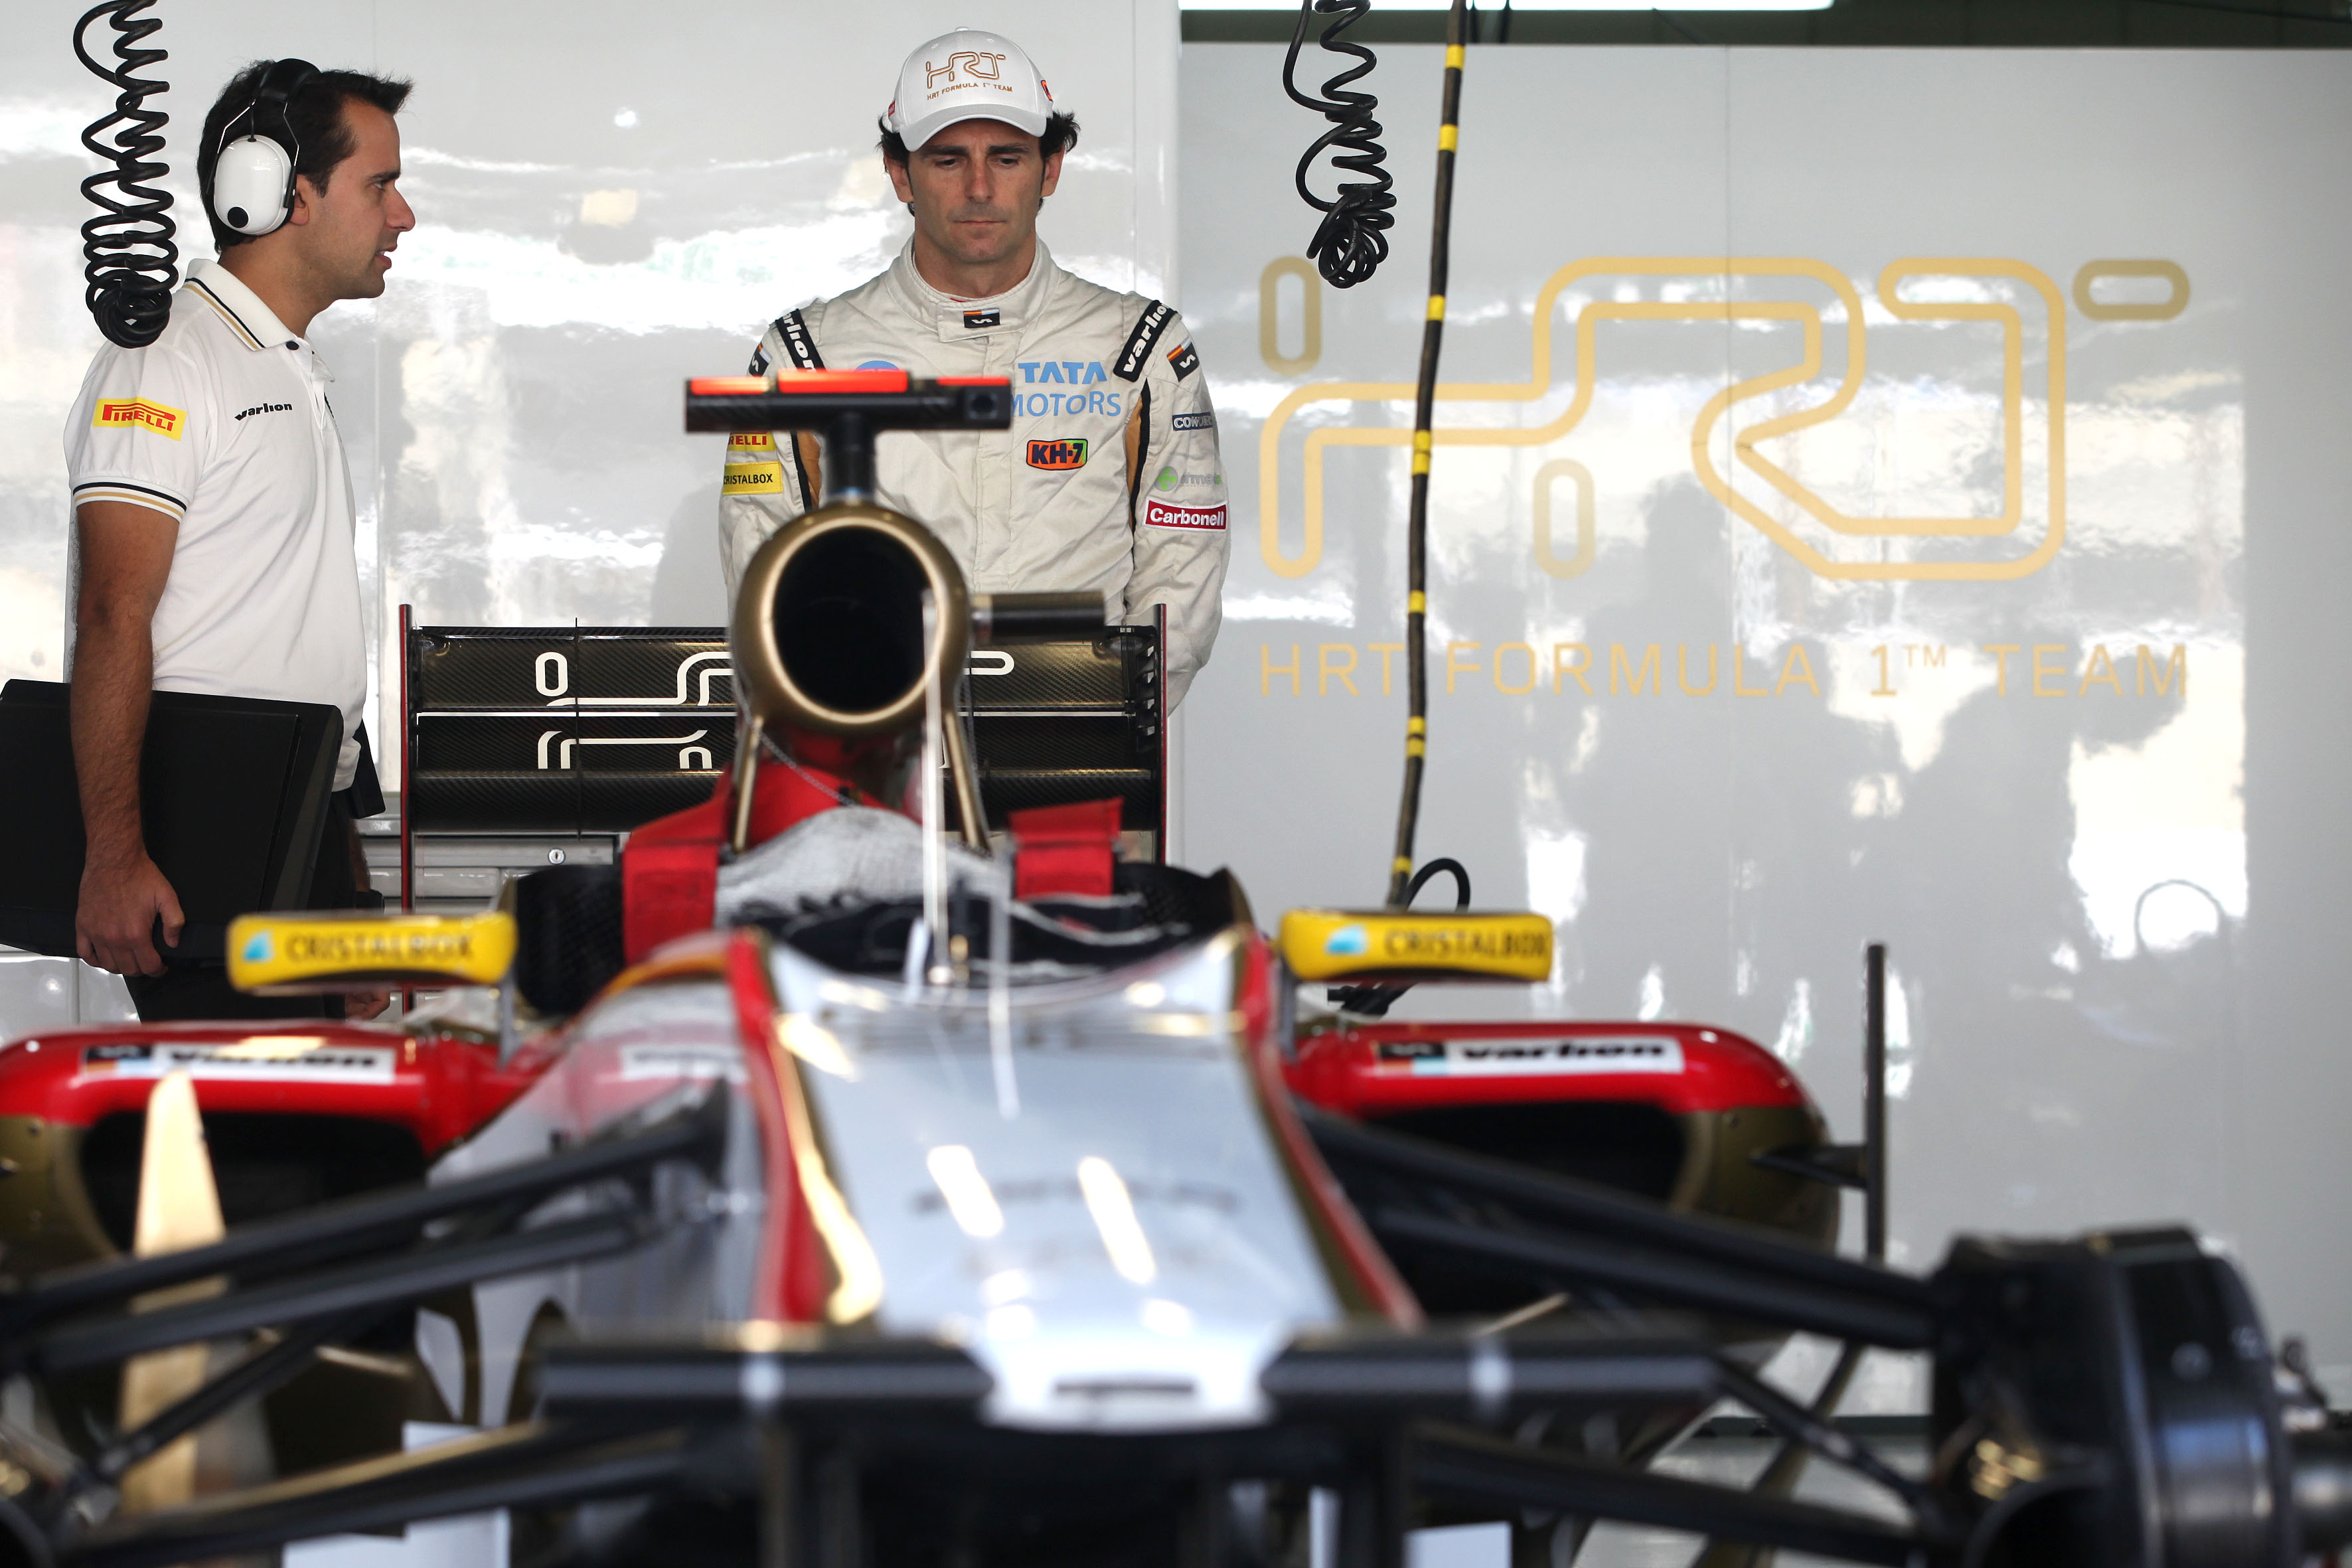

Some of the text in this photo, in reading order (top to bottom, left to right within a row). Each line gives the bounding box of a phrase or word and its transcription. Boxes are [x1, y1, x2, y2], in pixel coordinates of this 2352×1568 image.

[927, 91, 940, 101] HRT
[941, 82, 979, 95] FORMULA
[993, 84, 1014, 92] TEAM
[1123, 303, 1169, 372] varlio
[1018, 361, 1108, 385] TATA
[234, 402, 293, 421] varlion
[1010, 390, 1121, 417] MOTORS
[102, 402, 176, 432] PIRELLI
[1032, 443, 1083, 465] KH-7
[1150, 508, 1224, 526] Carbonell
[1261, 643, 1405, 696] HRT
[1446, 641, 1820, 696] FORMULA
[1982, 644, 2186, 696] TEAM
